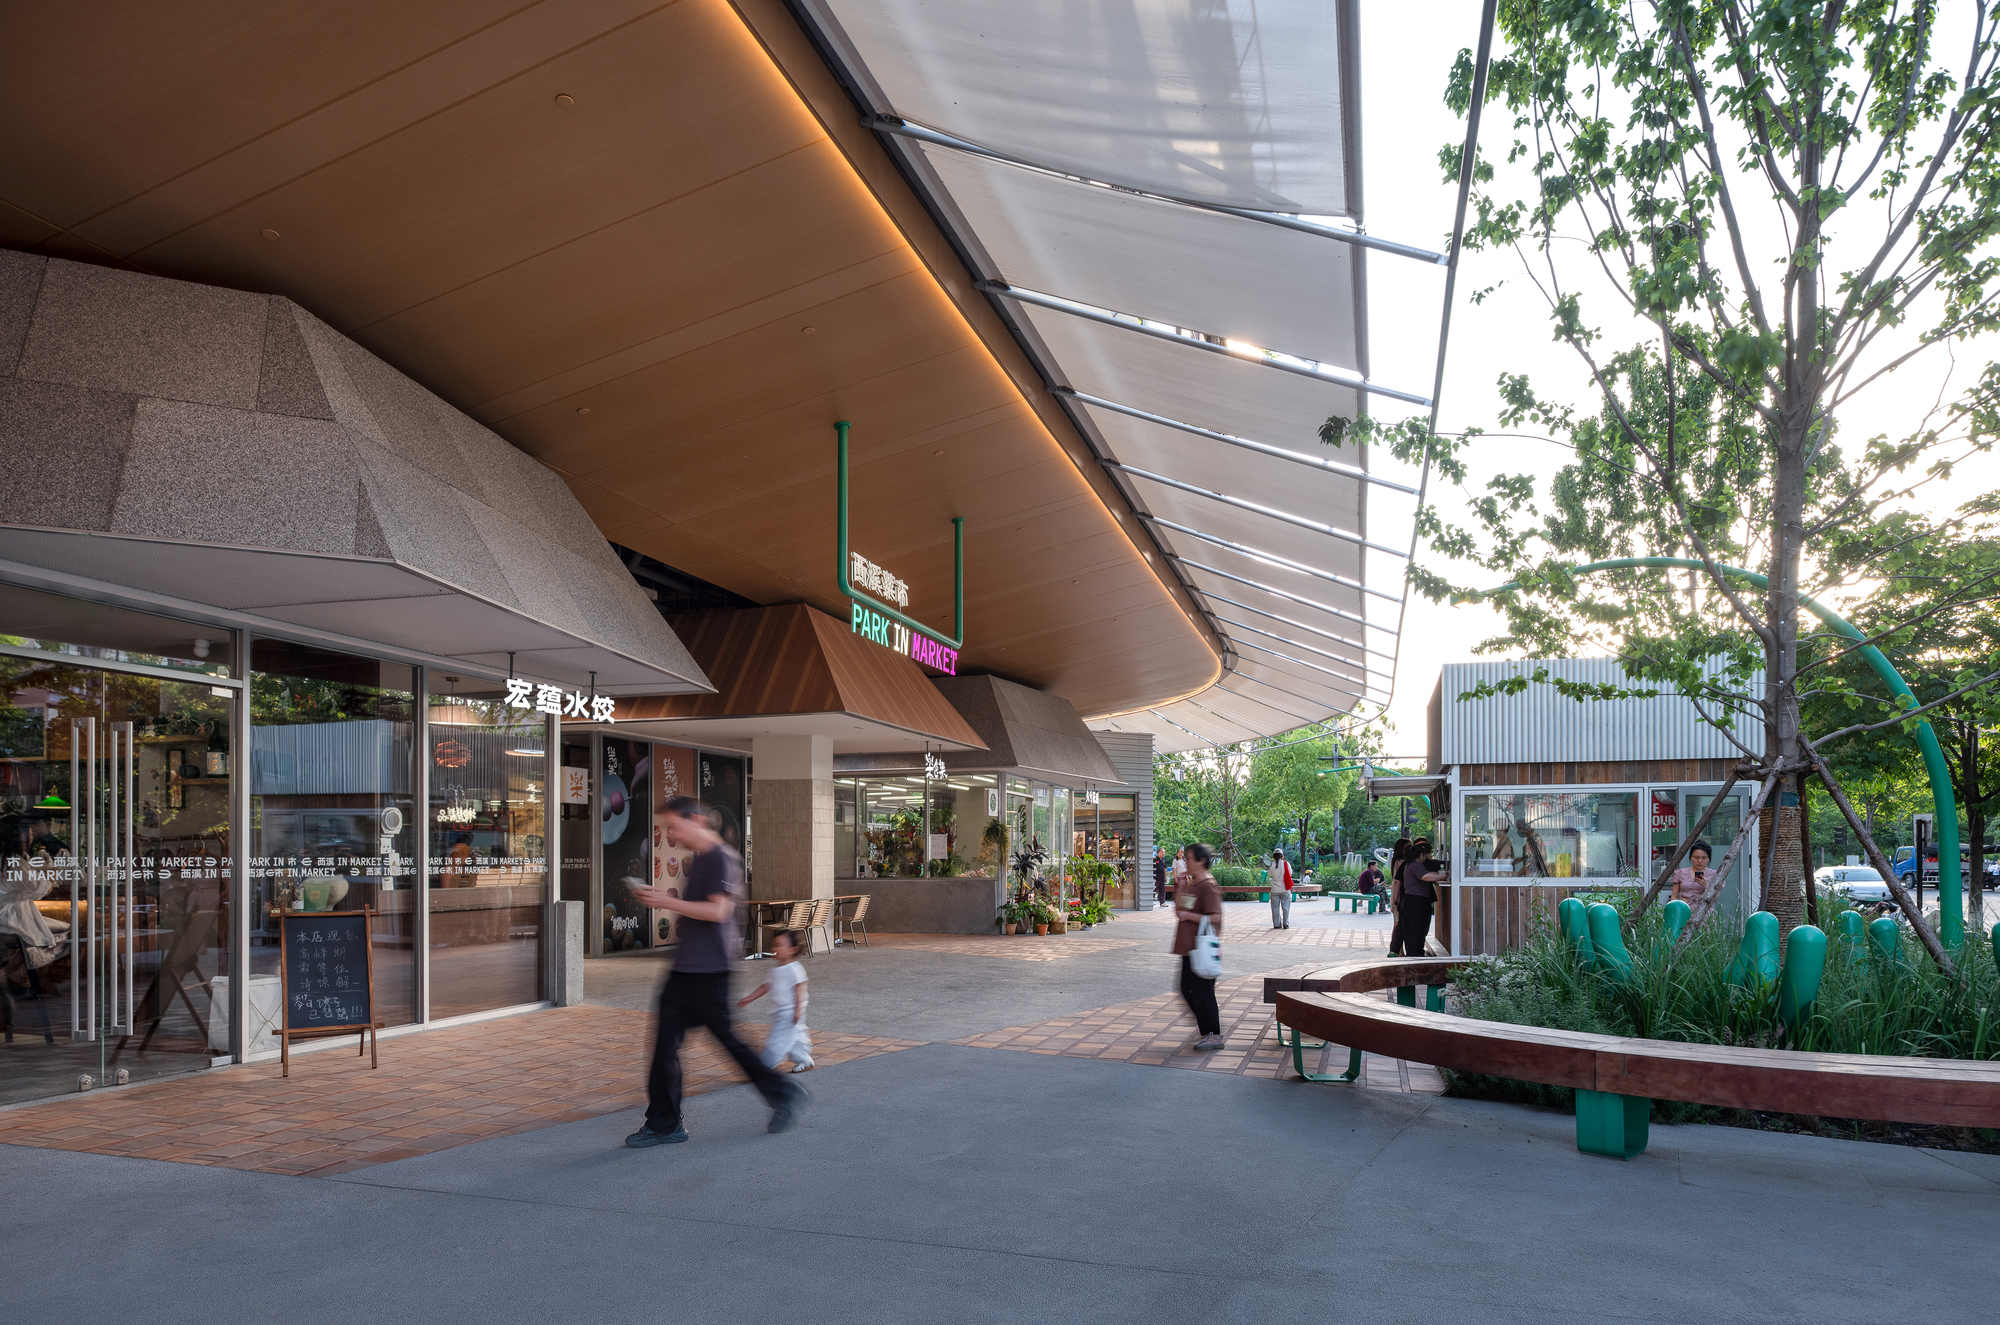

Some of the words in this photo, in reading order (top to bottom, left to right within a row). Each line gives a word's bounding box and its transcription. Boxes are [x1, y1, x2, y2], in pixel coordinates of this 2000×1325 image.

[851, 551, 909, 607] 西溪菜市
[852, 603, 890, 648] PARK
[893, 622, 909, 656] IN
[911, 632, 958, 676] MARKET
[504, 678, 616, 724] 宏蕴水饺
[140, 857, 154, 867] IN
[273, 857, 284, 867] IN
[338, 857, 348, 866] IN
[350, 857, 382, 866] MARKET
[445, 857, 453, 865] IN
[500, 857, 523, 865] MARKET
[6, 870, 22, 881] IN
[28, 870, 81, 880] MARKET
[205, 869, 217, 878] IN
[287, 868, 298, 877] IN
[301, 868, 336, 877] MARKET
[455, 866, 463, 874] IN
[465, 866, 489, 874] MARKET
